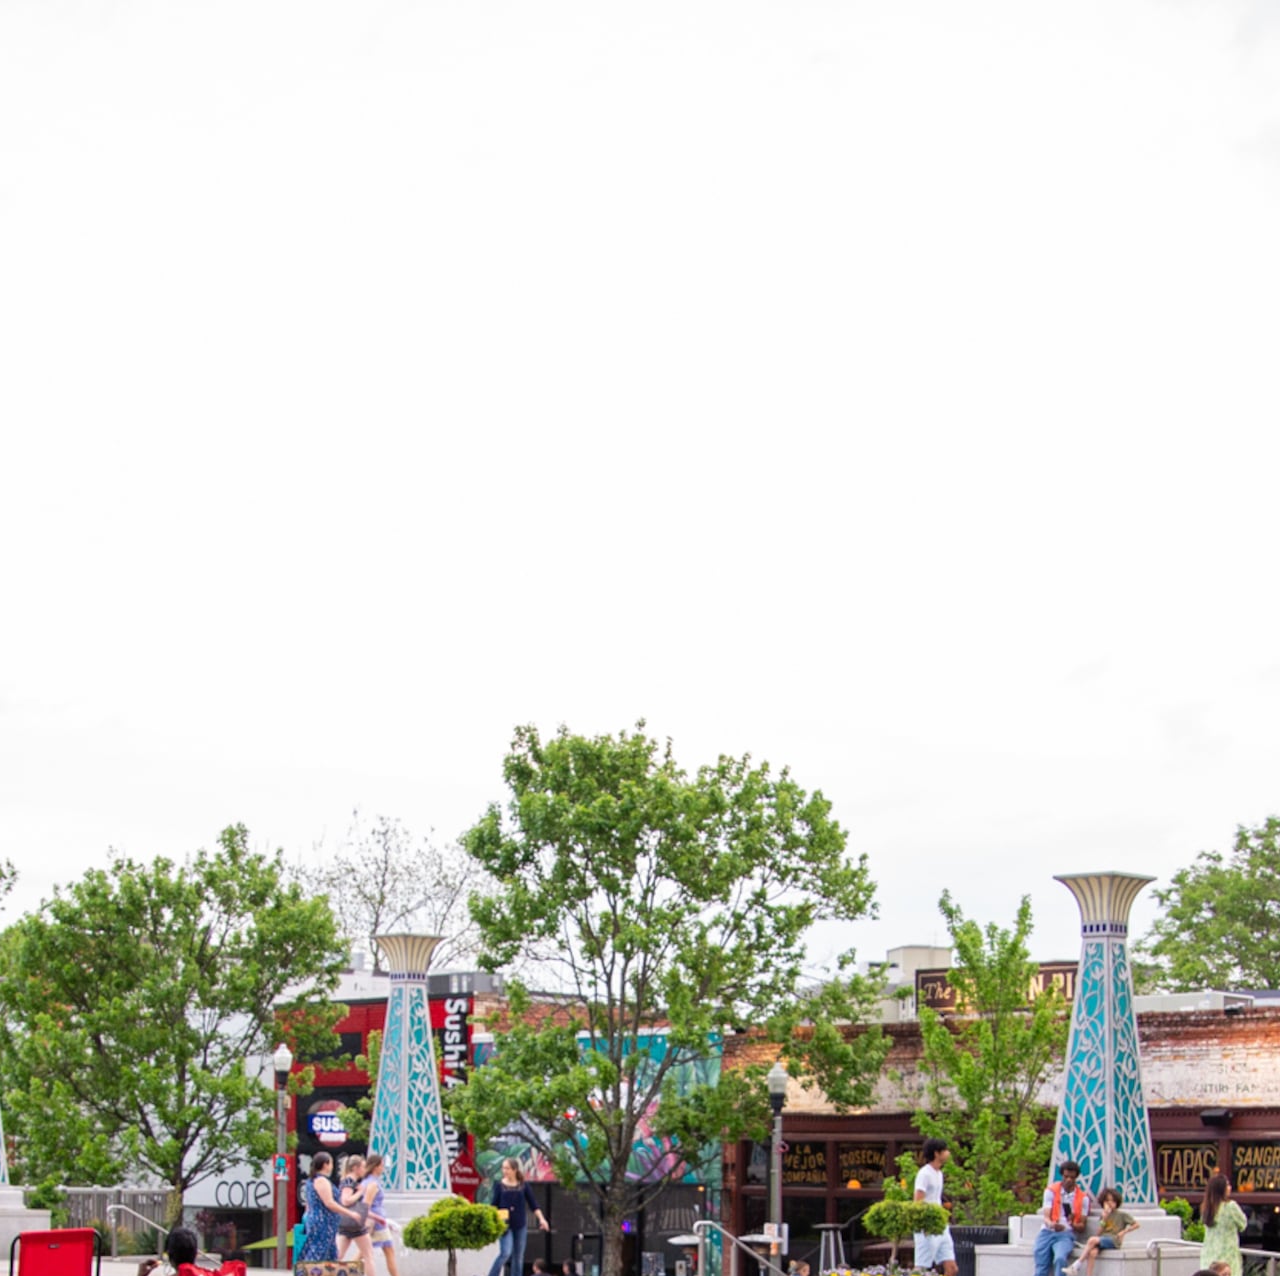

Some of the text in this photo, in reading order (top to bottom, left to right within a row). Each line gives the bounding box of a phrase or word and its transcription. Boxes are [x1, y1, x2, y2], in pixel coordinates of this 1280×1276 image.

[924, 982, 952, 1000] The
[444, 998, 467, 1068] Sushi
[311, 1116, 345, 1132] SUS
[796, 1144, 811, 1154] LA
[1160, 1149, 1215, 1186] TAPAS
[215, 1180, 271, 1209] core
